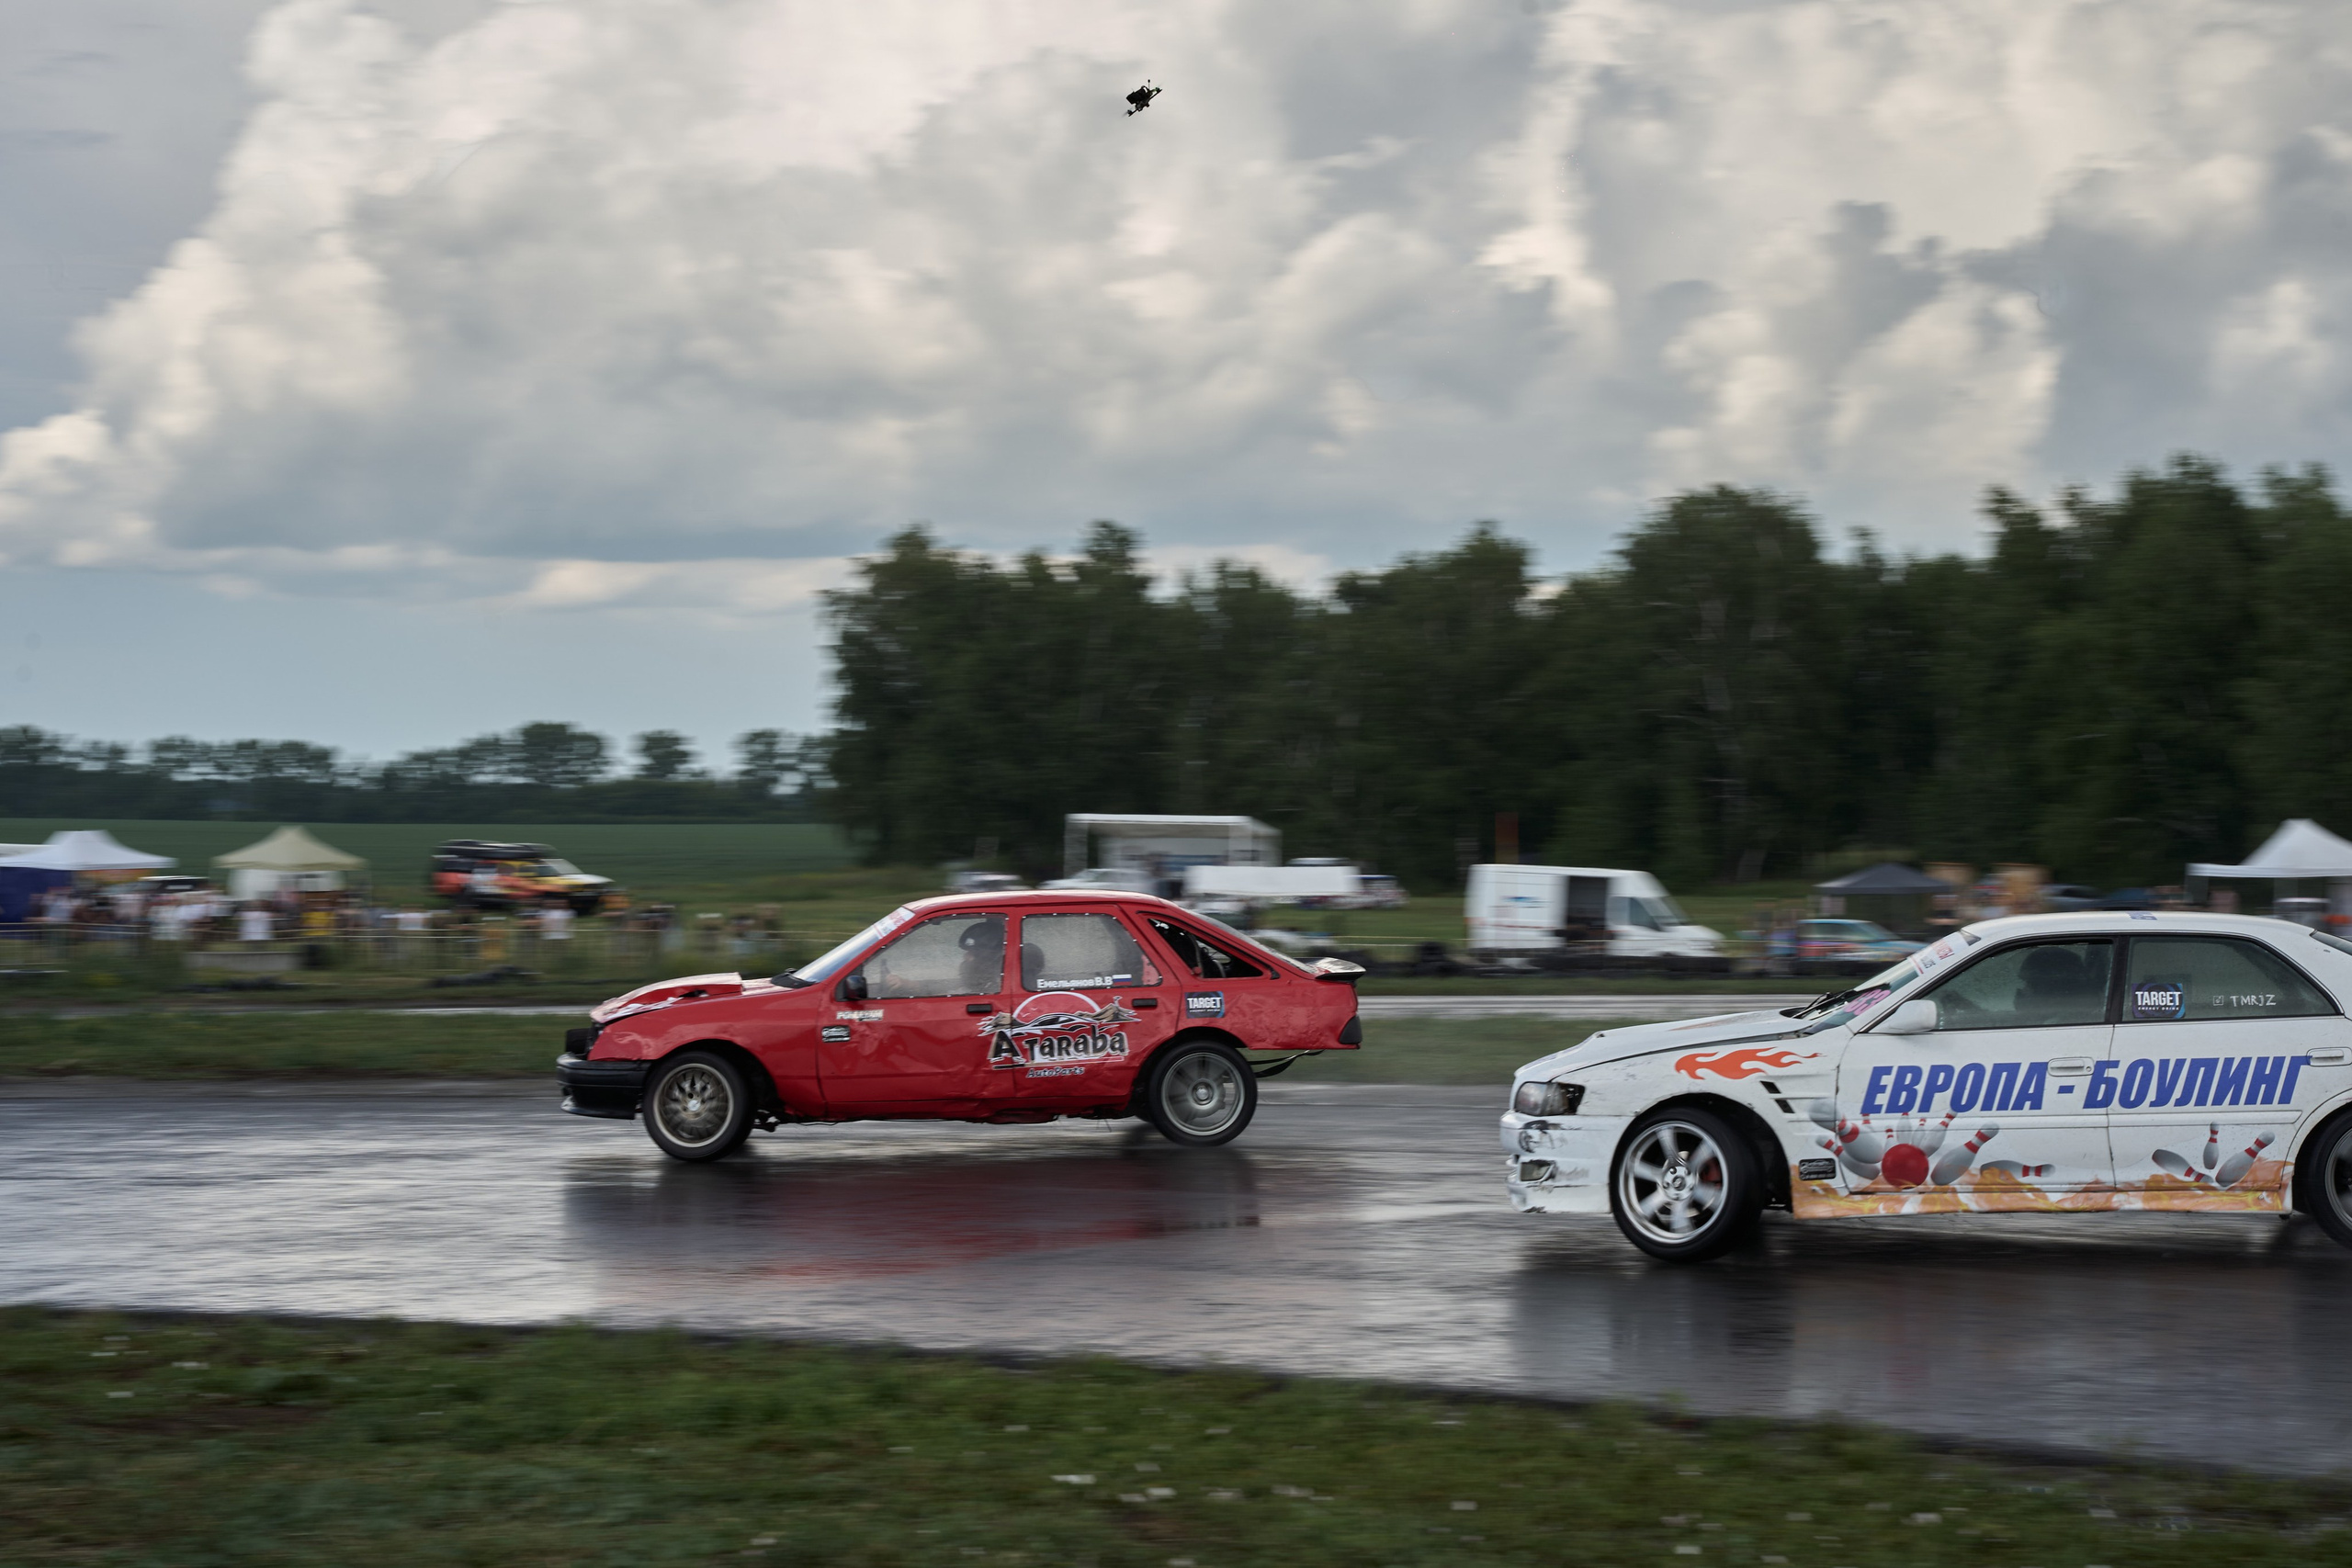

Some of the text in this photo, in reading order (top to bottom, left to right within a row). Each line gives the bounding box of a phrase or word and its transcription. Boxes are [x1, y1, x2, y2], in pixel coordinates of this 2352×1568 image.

[1187, 998, 1222, 1009] TARGET
[2135, 991, 2183, 1006] TARGET
[1026, 1066, 1085, 1078] AutoParts
[1860, 1062, 2048, 1114] ЕВРОПА
[2083, 1055, 2312, 1110] БОУЛИНГ
